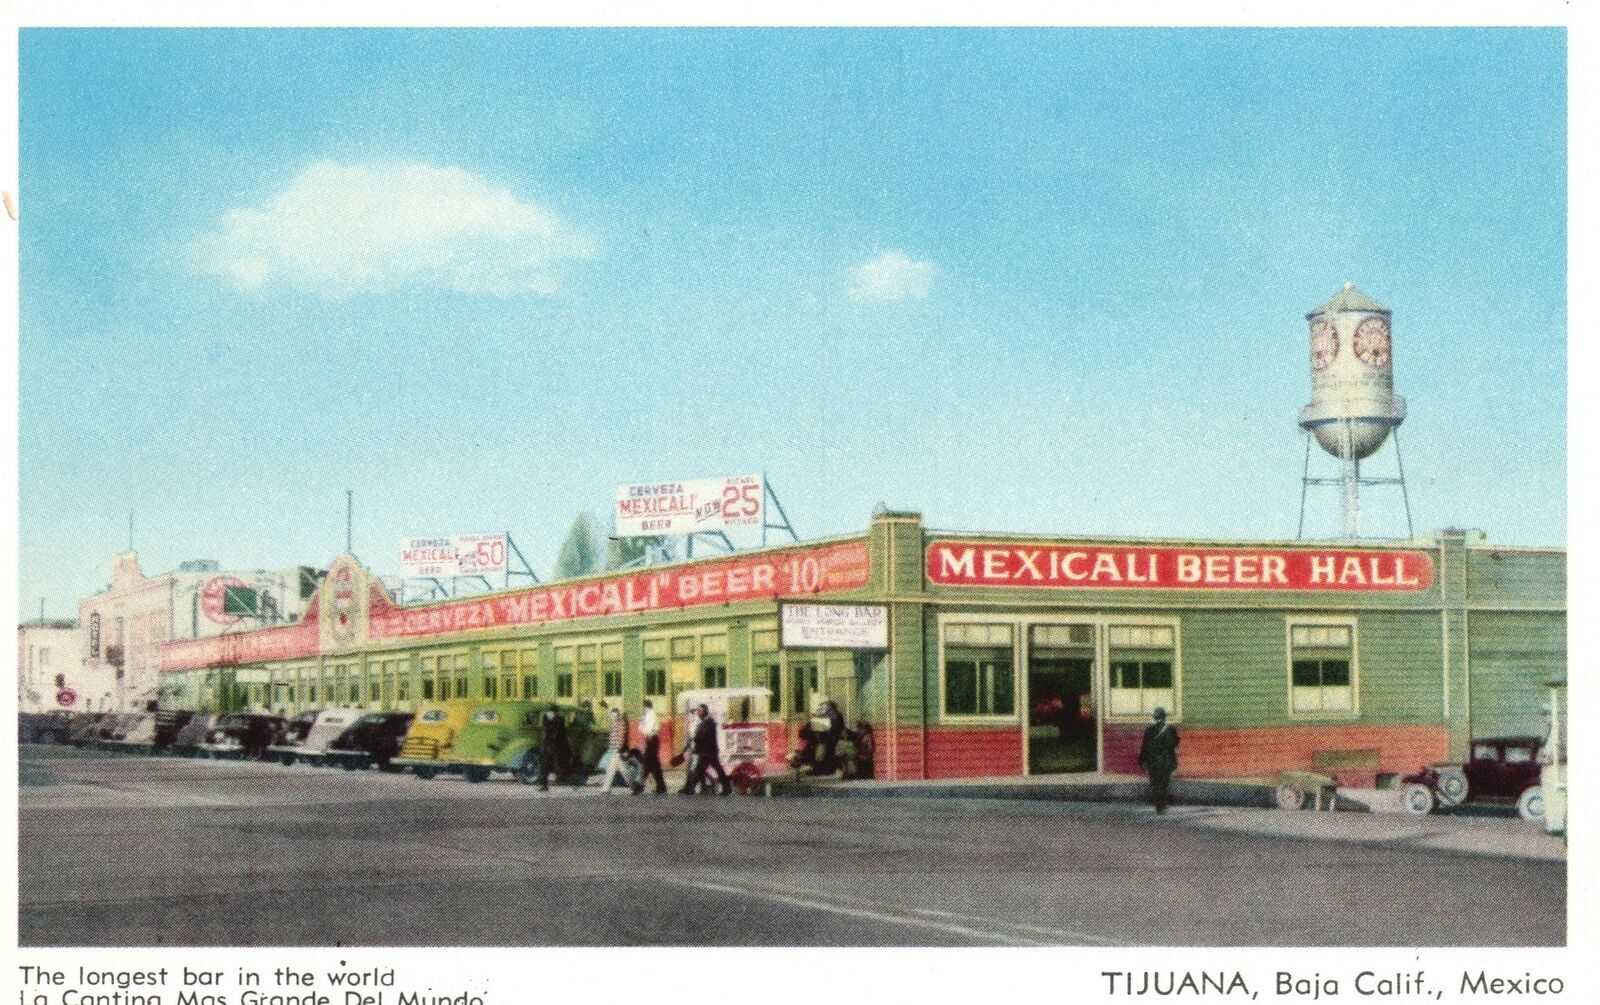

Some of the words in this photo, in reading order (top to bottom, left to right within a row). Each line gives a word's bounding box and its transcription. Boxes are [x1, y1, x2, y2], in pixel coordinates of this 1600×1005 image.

[629, 484, 683, 496] CERVEZA
[722, 484, 759, 518] 25
[695, 498, 721, 519] NOW
[641, 519, 671, 530] BEER
[477, 540, 504, 565] 50
[939, 547, 1157, 585] MEXICALI
[1176, 553, 1288, 586] BEER
[1311, 555, 1419, 588] HALL
[405, 603, 495, 631] CERVEZA
[679, 564, 775, 600] BEER
